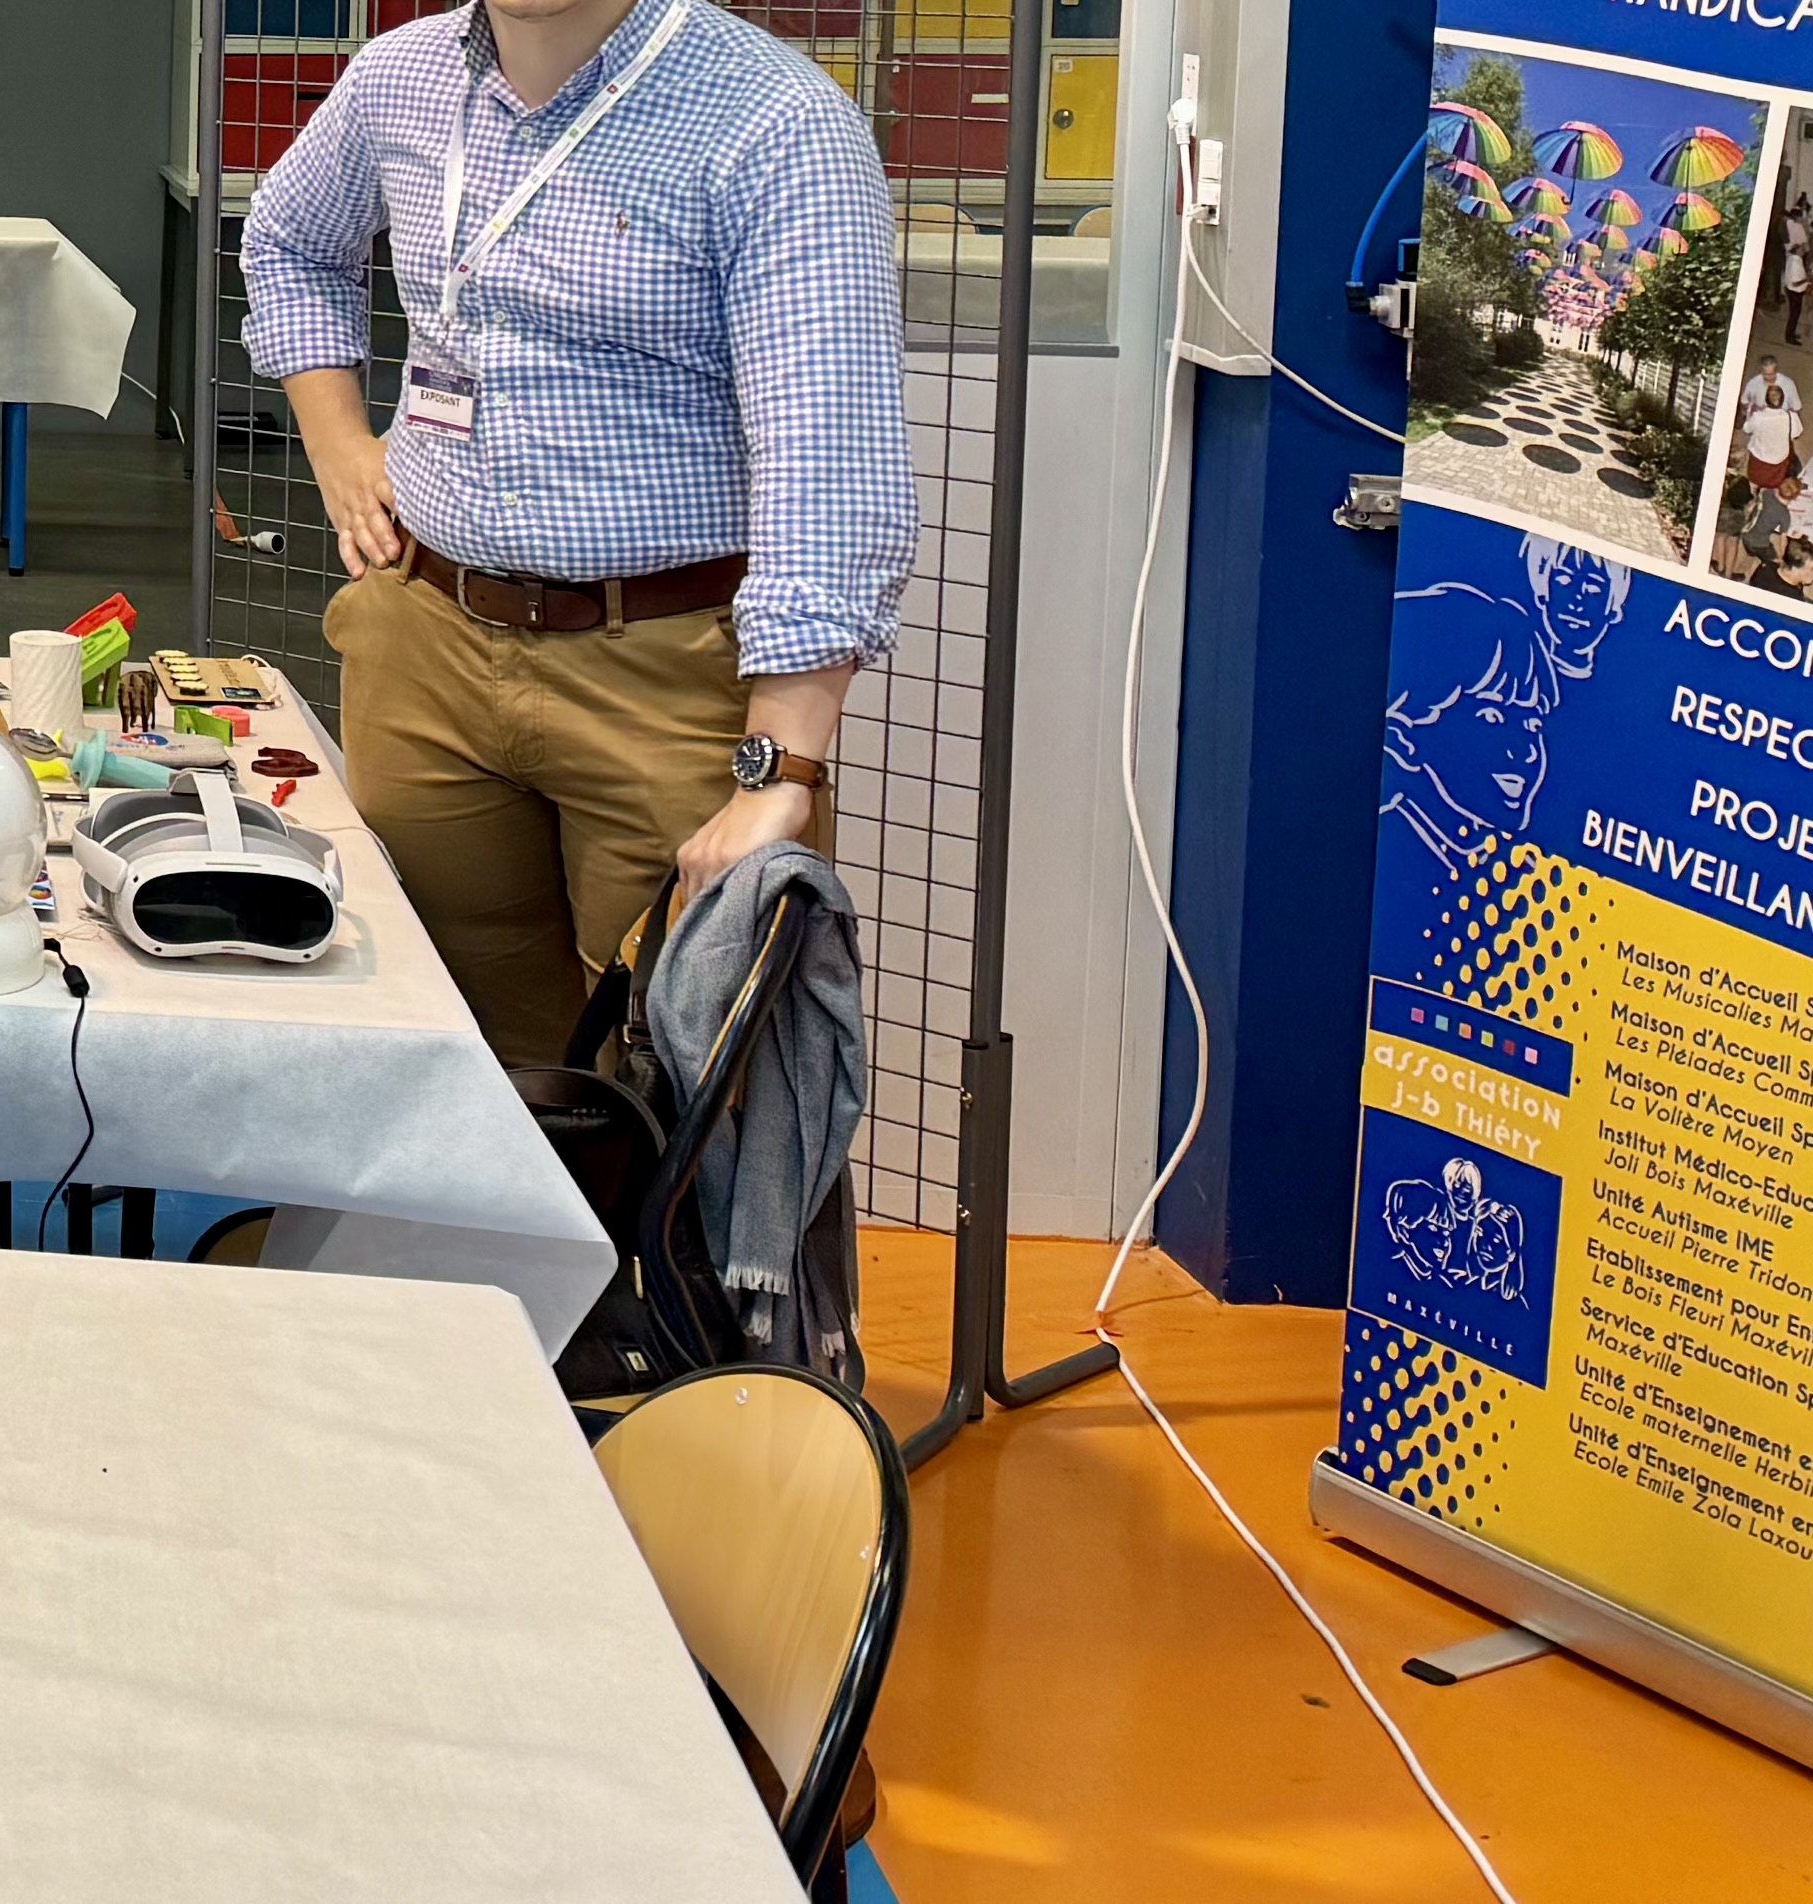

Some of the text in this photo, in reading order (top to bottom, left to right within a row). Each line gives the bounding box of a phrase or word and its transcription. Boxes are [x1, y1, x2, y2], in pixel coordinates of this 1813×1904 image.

[1618, 941, 1798, 1012] Maison d'Accueil
[1622, 967, 1655, 992] Les
[1663, 980, 1772, 1029] Musicalies
[1611, 1000, 1791, 1074] Maison d'Accueil
[1616, 1027, 1745, 1084] Les Pléiades
[1392, 1082, 1440, 1117] j-b
[1605, 1060, 1784, 1137] Maison d'Accueil
[1610, 1086, 1794, 1165] La Volière Moyen
[1599, 1120, 1666, 1159] Institut
[1593, 1178, 1774, 1262] Unité Autisme IME
[1605, 1147, 1794, 1229] Joli Bois Maxéville
[1587, 1237, 1780, 1328] Etablissement pour
[1597, 1207, 1813, 1302] Accueil Pierre Tridon
[1592, 1264, 1724, 1331] Le Bois Fleuri
[1581, 1297, 1788, 1396] Service d'Education
[1587, 1324, 1682, 1377] Maxéville
[1575, 1354, 1791, 1462] Unité d'Enseignement
[1580, 1382, 1747, 1468] Ecole maternelle
[1569, 1412, 1784, 1523] Unité d'Enseignement
[1574, 1440, 1813, 1560] Ecole Emile Zola Laxou
